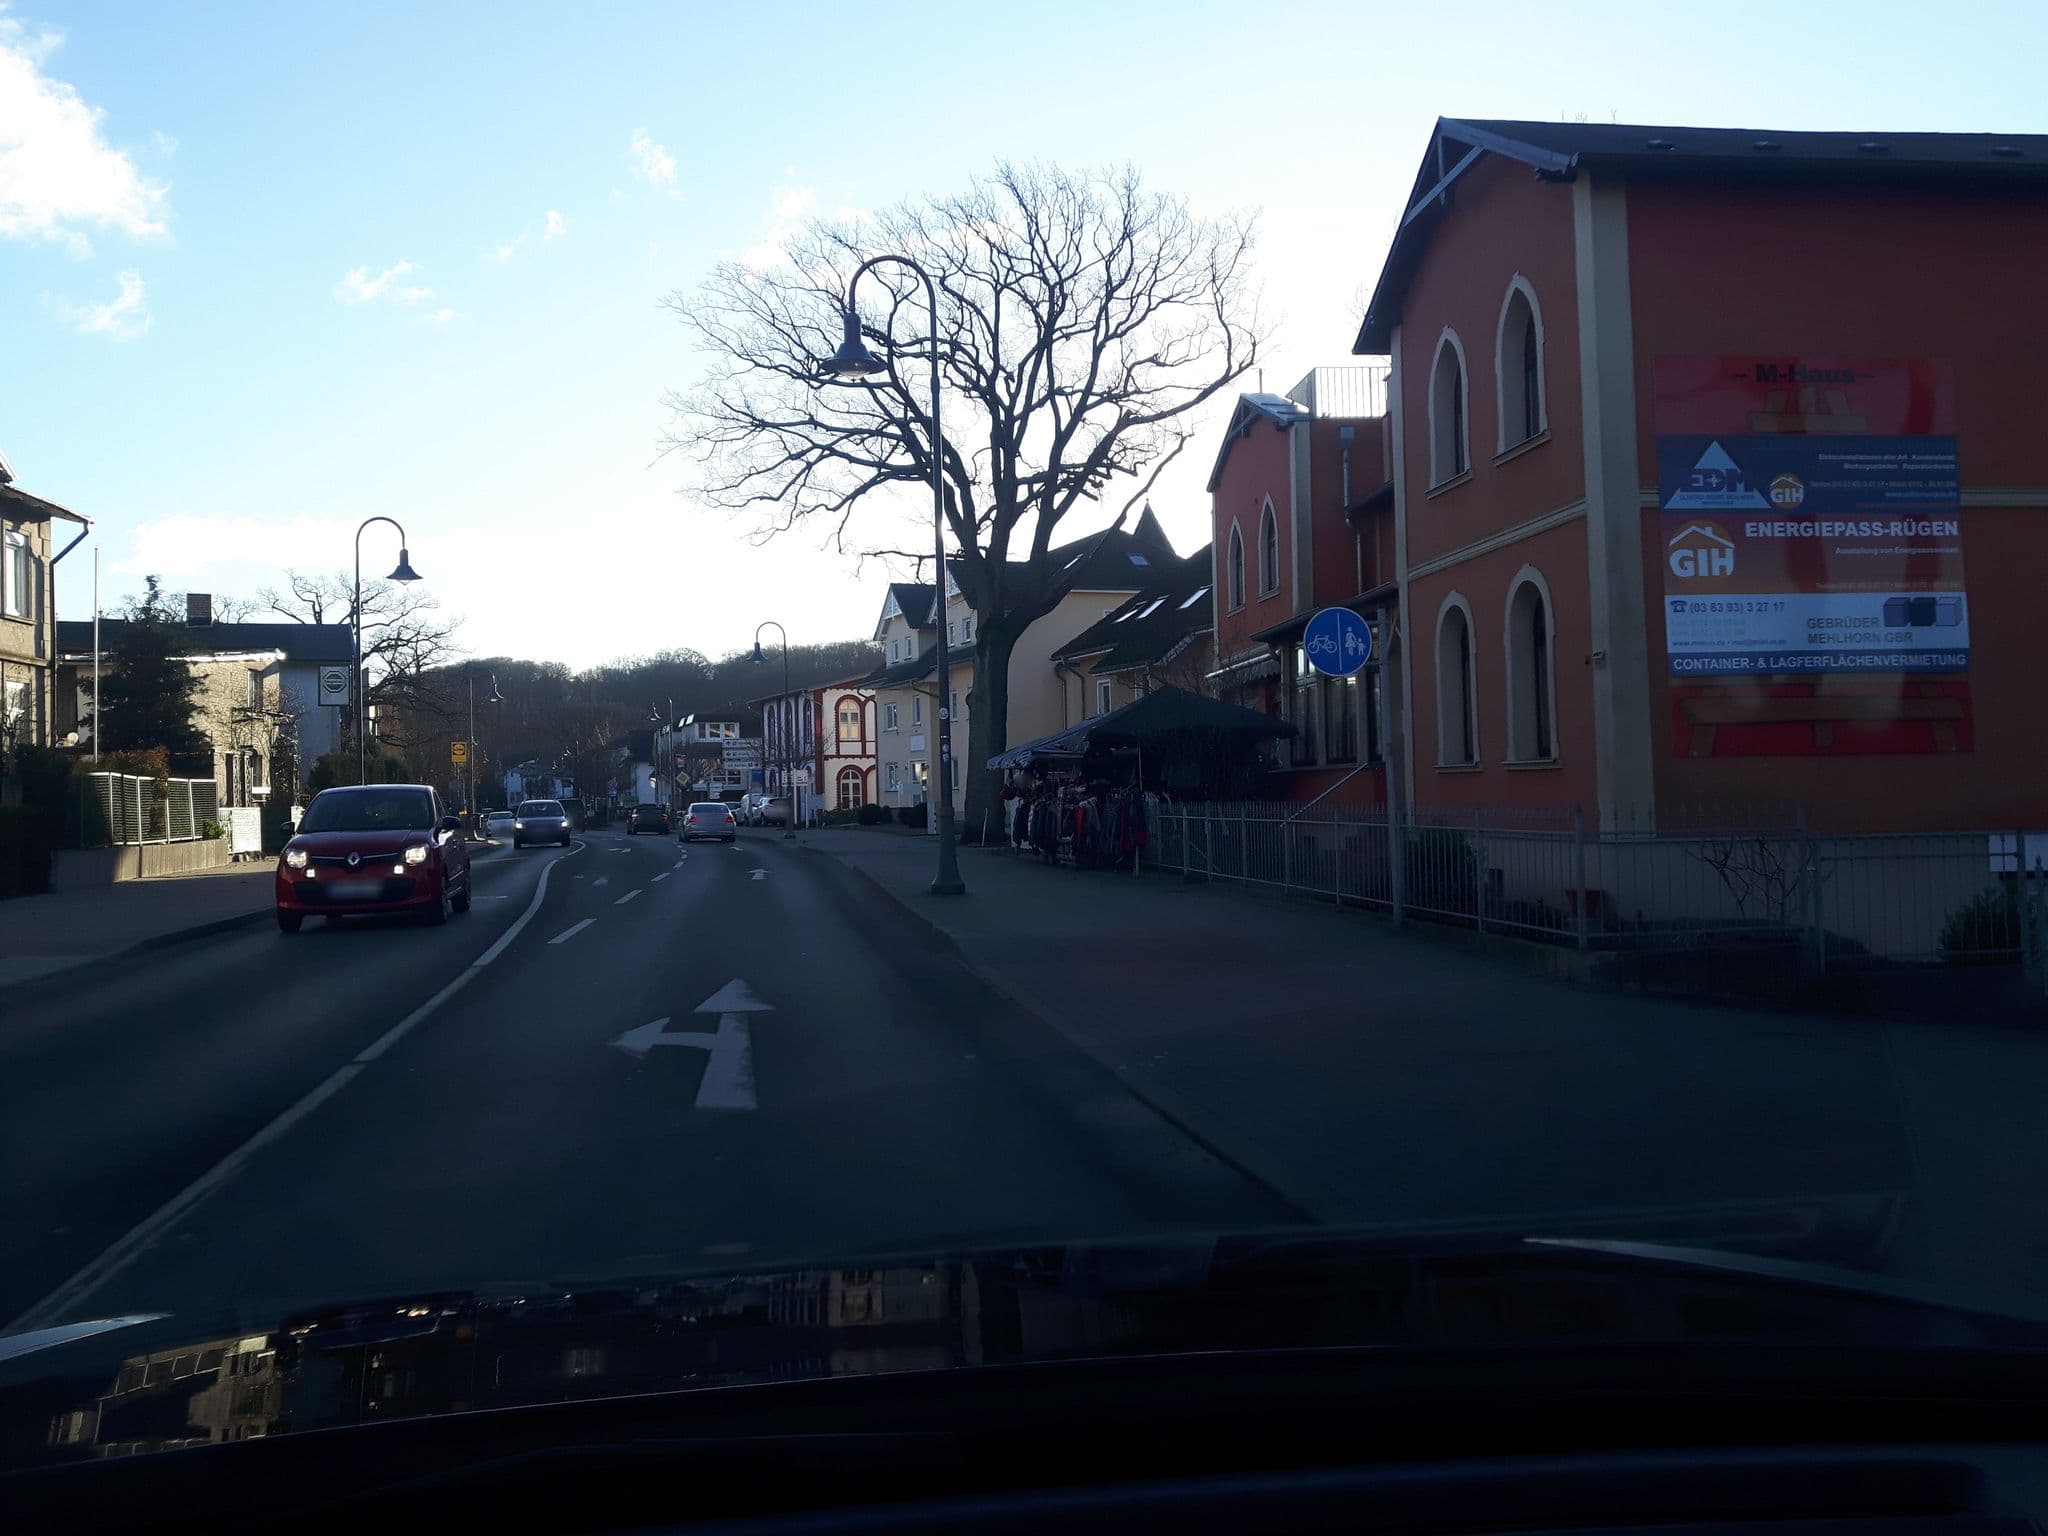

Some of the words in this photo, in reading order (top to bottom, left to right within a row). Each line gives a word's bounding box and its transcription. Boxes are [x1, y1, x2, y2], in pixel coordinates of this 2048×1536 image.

[1770, 489, 1804, 503] GIH
[1746, 519, 1959, 537] ENERGIEPASS-RÜGEN
[1669, 548, 1734, 577] GIH
[1756, 601, 1769, 612] 27
[1807, 616, 1880, 629] GEBRÜDER
[1807, 631, 1881, 643] MEHLHORN
[1885, 631, 1913, 642] GBR
[1673, 658, 1754, 670] CONTAINER-
[1756, 657, 1767, 669] &
